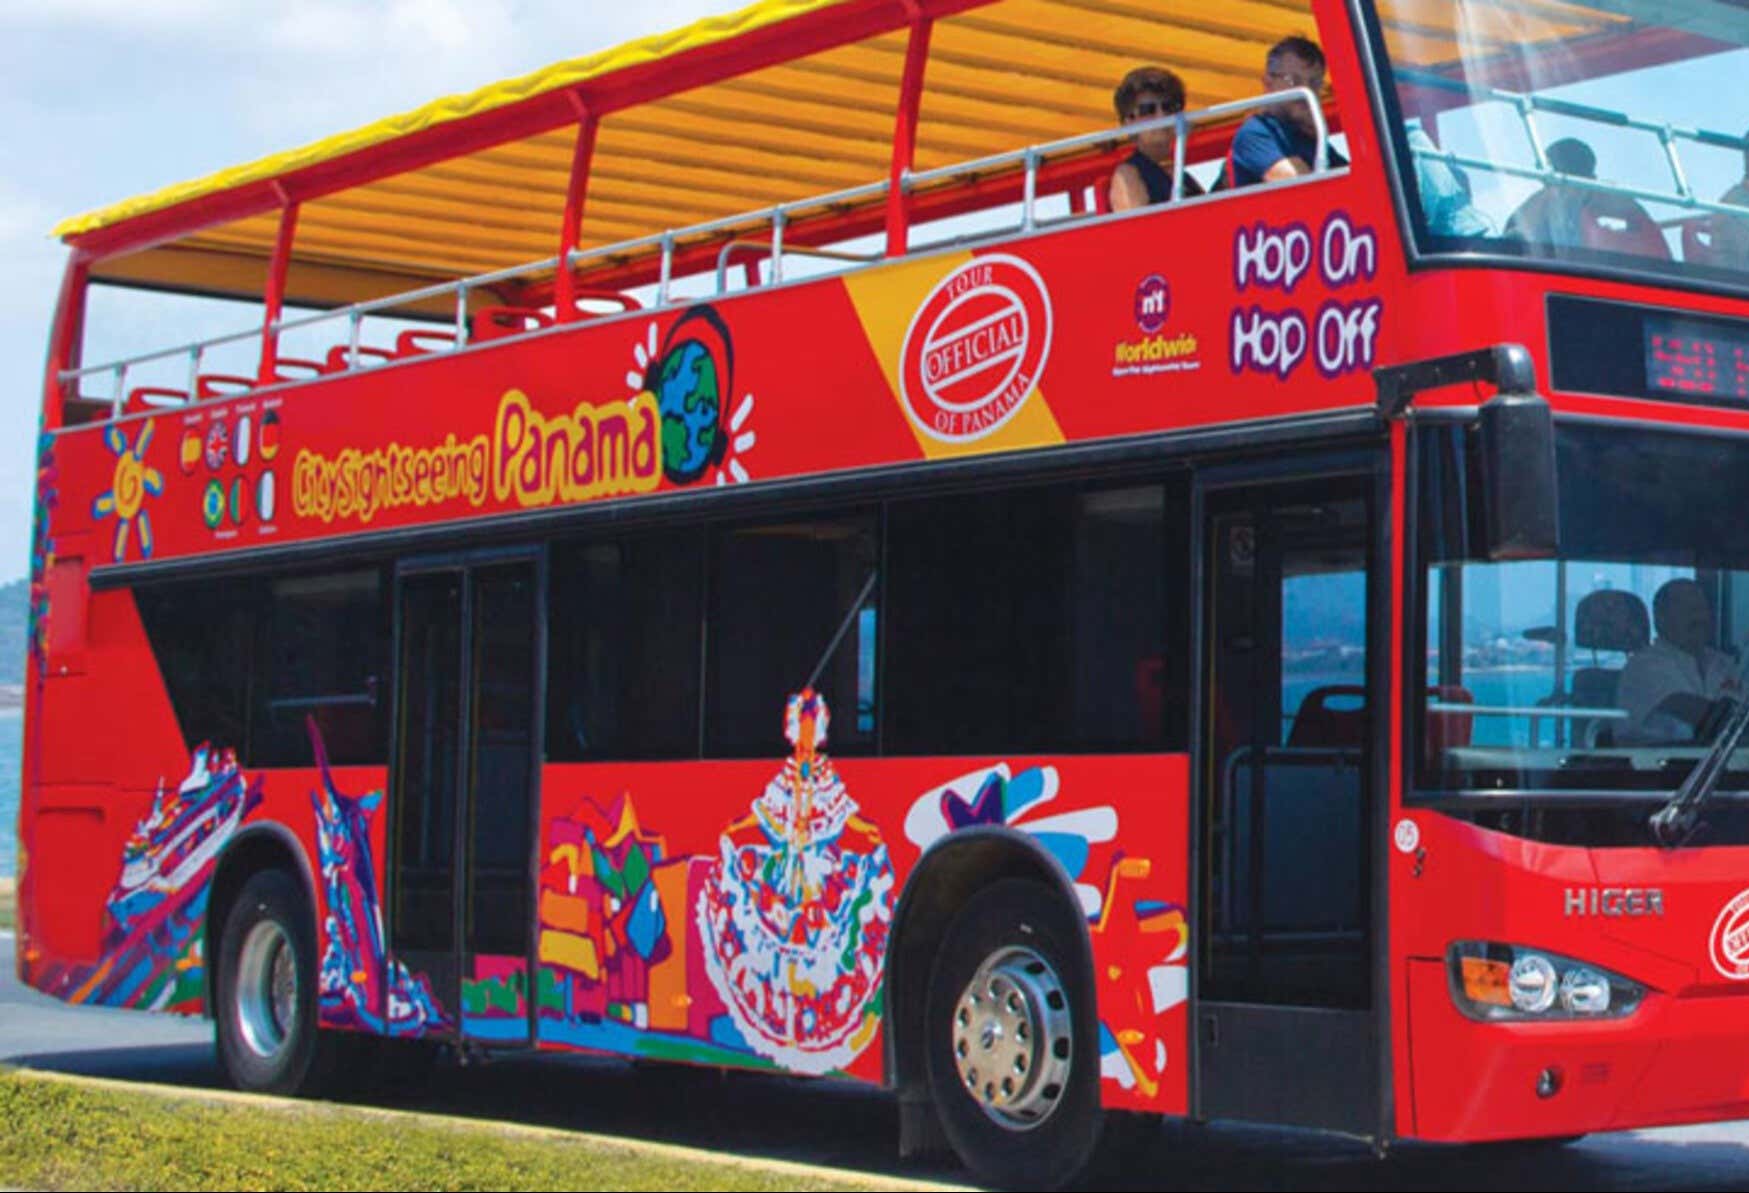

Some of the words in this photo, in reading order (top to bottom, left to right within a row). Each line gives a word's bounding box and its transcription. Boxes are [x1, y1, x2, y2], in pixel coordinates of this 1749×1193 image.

[945, 265, 993, 301] TOUR
[1236, 227, 1311, 288] Hop
[1322, 216, 1376, 282] On
[925, 316, 1024, 382] OFFICIAL
[1232, 314, 1307, 374] Hop
[1316, 303, 1380, 371] Off
[935, 410, 958, 434] OF
[961, 371, 1030, 433] PANAMA
[498, 395, 659, 500] Panama
[1564, 887, 1665, 916] HIGER
